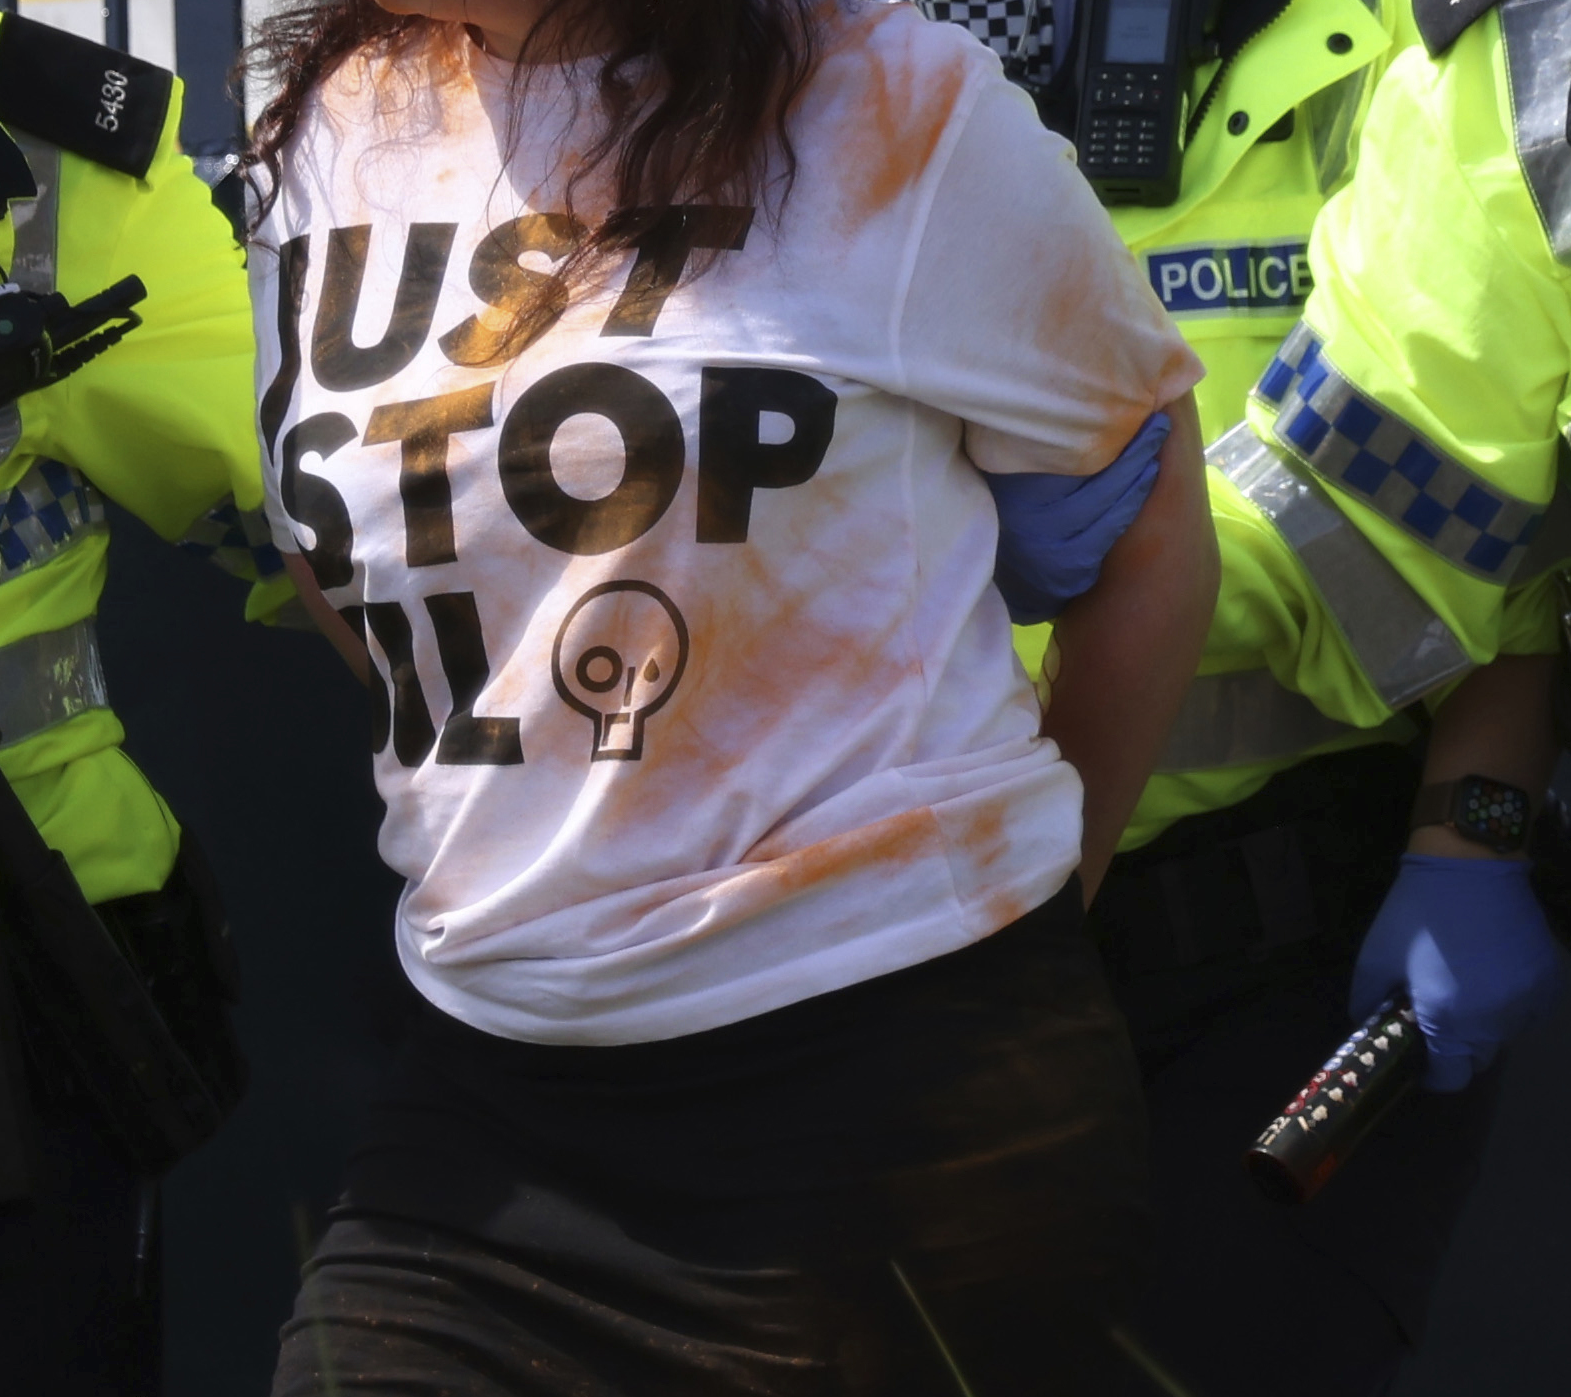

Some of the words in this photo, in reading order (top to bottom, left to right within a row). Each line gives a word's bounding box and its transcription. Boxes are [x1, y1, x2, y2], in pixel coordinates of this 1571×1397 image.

[94, 69, 129, 133] 5430
[260, 206, 755, 468] JUST
[1160, 253, 1313, 303] POLICE
[282, 362, 837, 591] STOP
